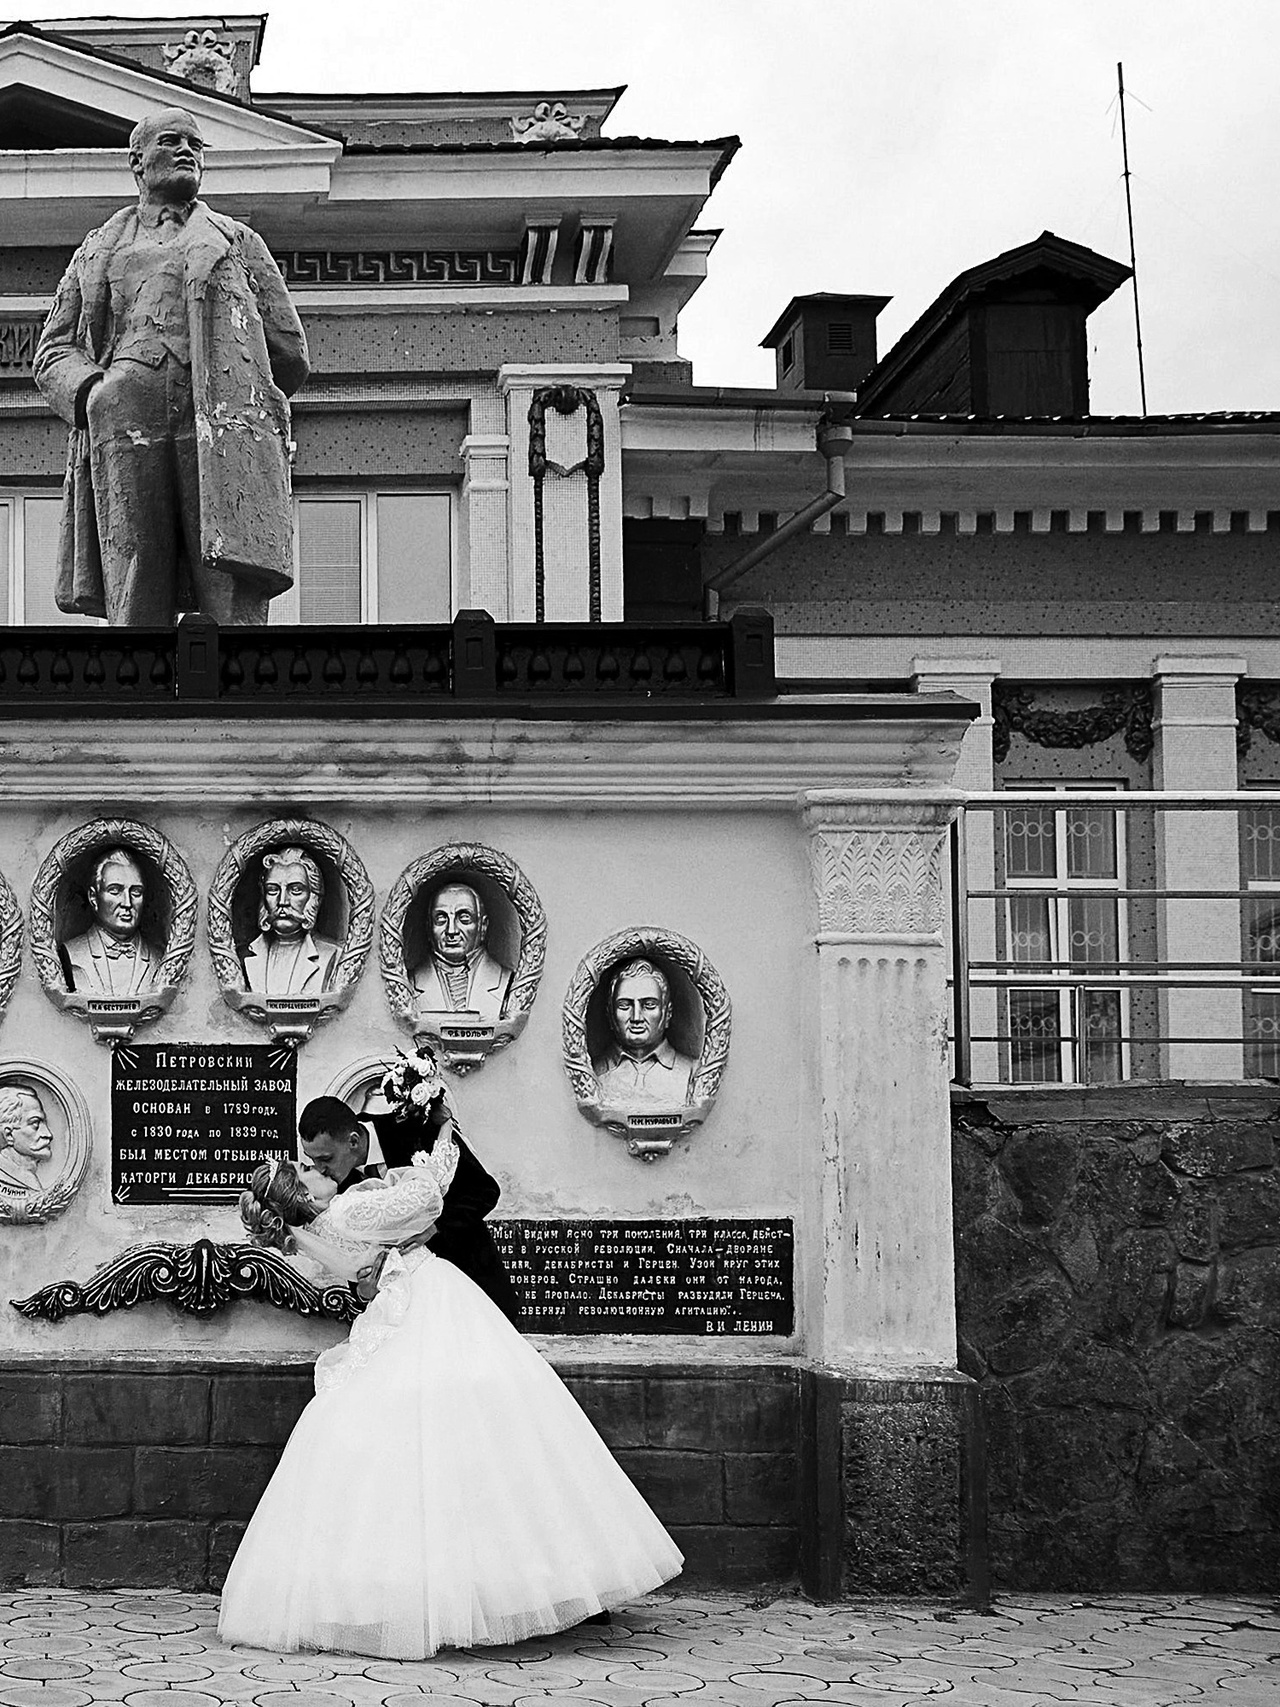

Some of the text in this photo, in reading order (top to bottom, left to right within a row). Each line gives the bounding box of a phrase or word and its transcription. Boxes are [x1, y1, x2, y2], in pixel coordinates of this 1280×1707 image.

[115, 1076, 292, 1093] ЖЕЛЕЗОДЕЛАТЕЛЬНЫЙ ЗАВОД
[132, 1101, 191, 1115] ОСНОВАН
[223, 1102, 250, 1115] 1789
[143, 1125, 173, 1138] 1830
[230, 1125, 257, 1138] 1839
[119, 1148, 290, 1162] БЫЛ МЕСТОМ ОТБЫВАНИЯ
[120, 1171, 177, 1184] КАТОРГИ
[523, 1228, 559, 1242] ВИДИМ
[566, 1228, 593, 1241] ЯСНО
[599, 1229, 619, 1239] ТРИ
[688, 1229, 707, 1239] ТРИ
[535, 1242, 580, 1256] РУССКОЙ
[544, 1259, 614, 1271] ДЕКАБРИСТЫ
[723, 1259, 749, 1269] КРУГ
[754, 1259, 780, 1269] ЭТИХ
[568, 1272, 619, 1285] СТРАШНО
[633, 1275, 676, 1285] ДАЛЕКИ
[685, 1275, 706, 1285] ОНИ
[716, 1275, 730, 1285] ОТ
[524, 1290, 537, 1300] НЕ
[598, 1286, 665, 1301] ДЕКАБРИСТЫ
[677, 1290, 734, 1301] РАЗБУДИЛИ
[578, 1306, 665, 1316] РЕВОЛЮЦИОННУЮ
[733, 1320, 773, 1333] ЛЕНИН
